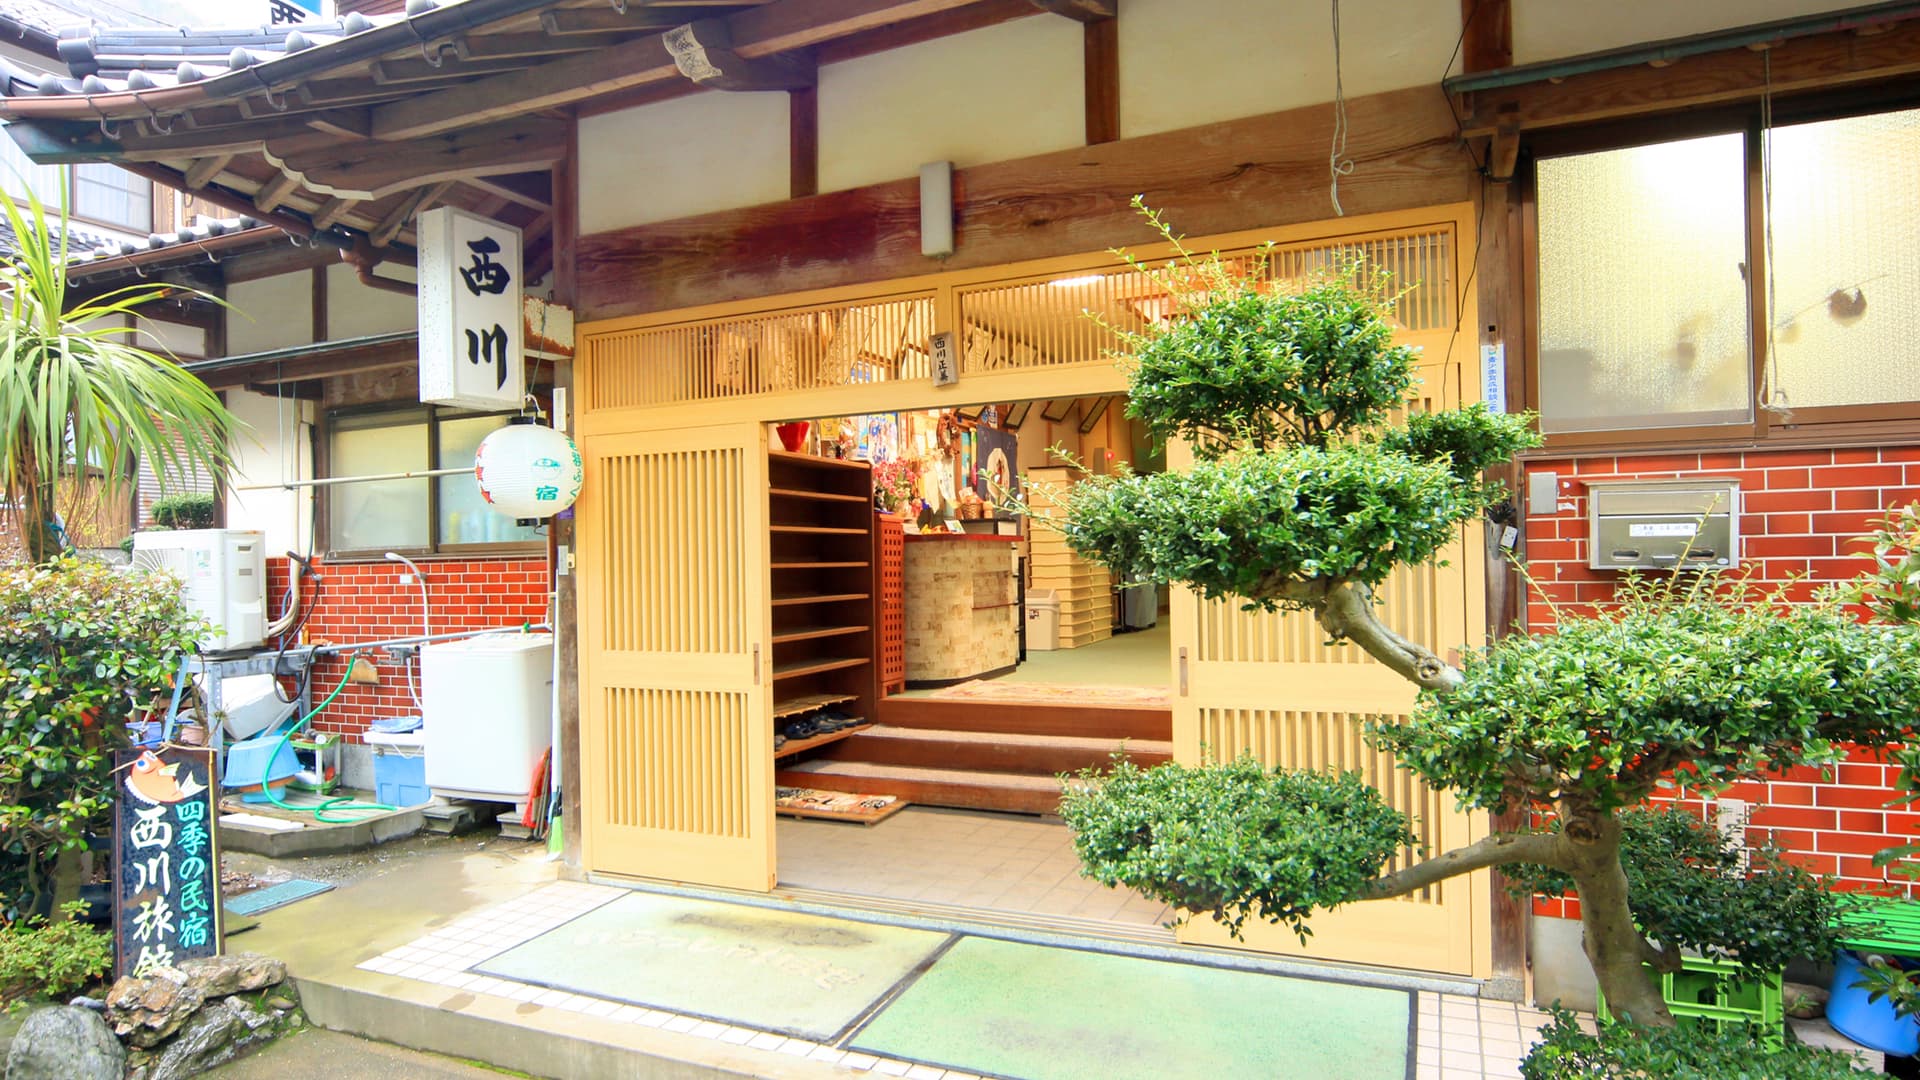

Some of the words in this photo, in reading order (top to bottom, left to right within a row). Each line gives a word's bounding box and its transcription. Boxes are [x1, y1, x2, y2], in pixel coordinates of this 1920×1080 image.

[459, 236, 511, 391] 西川
[536, 485, 559, 501] 宿
[175, 801, 209, 949] 四季の民宿
